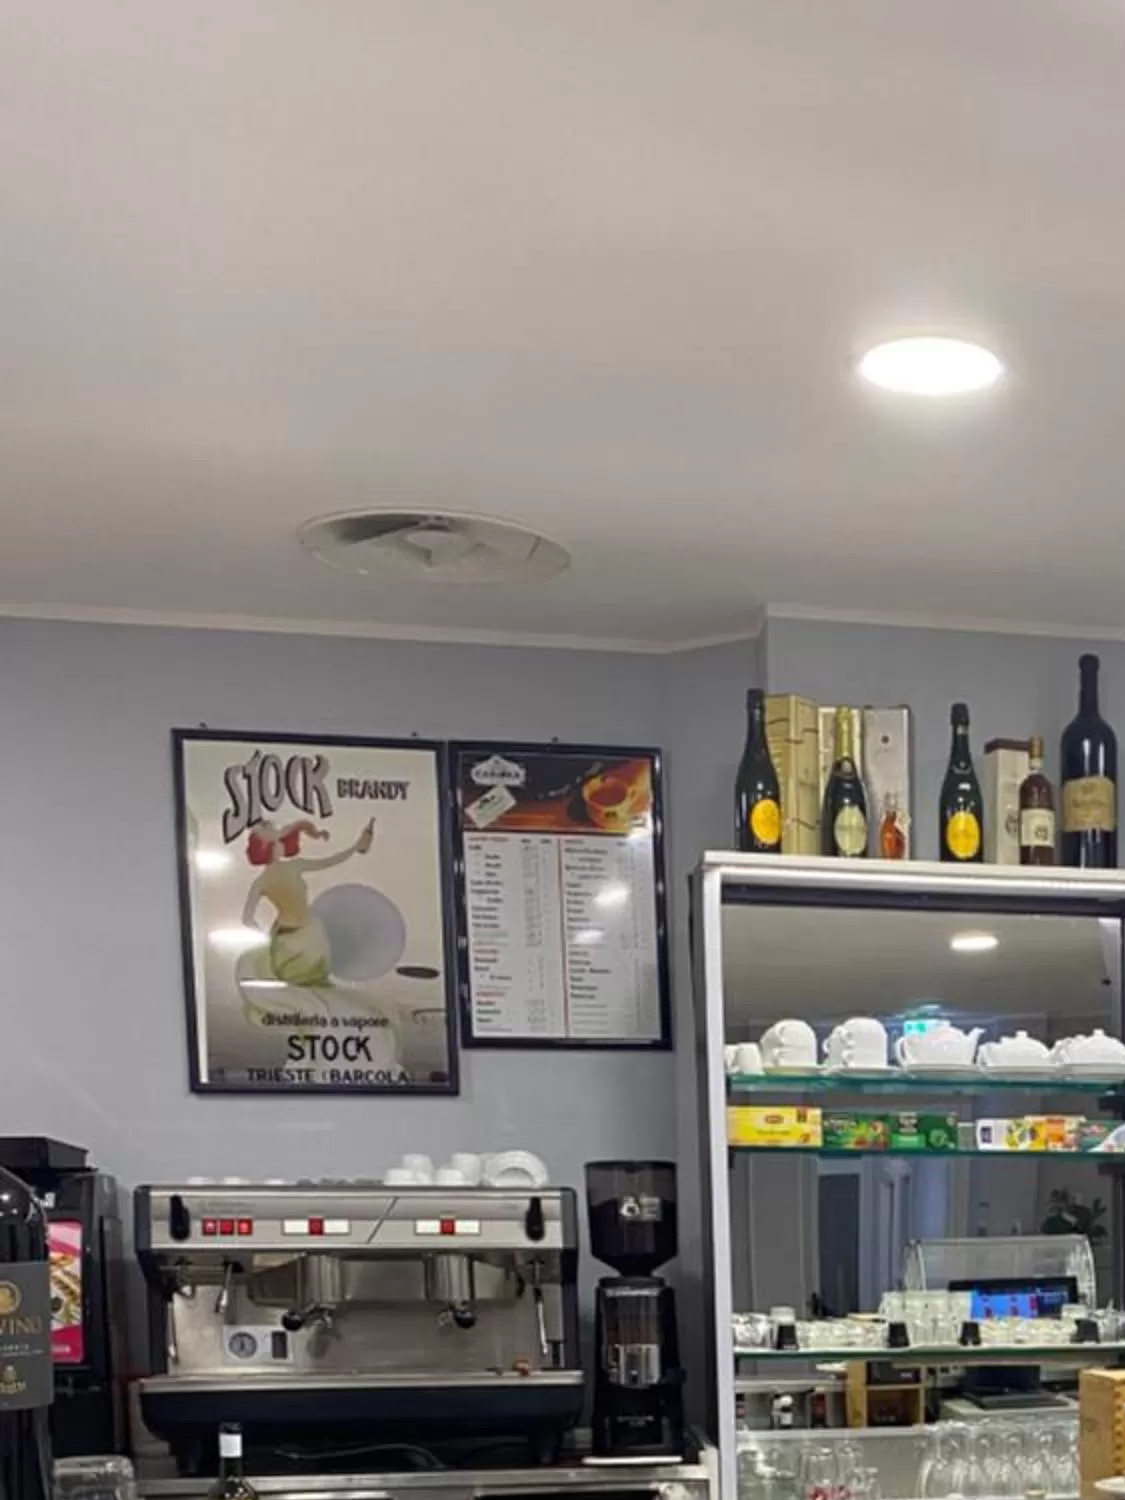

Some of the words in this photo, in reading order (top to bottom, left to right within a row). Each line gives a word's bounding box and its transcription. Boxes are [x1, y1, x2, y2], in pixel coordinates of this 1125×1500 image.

[222, 750, 333, 844] STOCK
[337, 777, 410, 800] BRANDY
[288, 1034, 373, 1062] STOCK
[246, 1067, 316, 1083] TRIESTE
